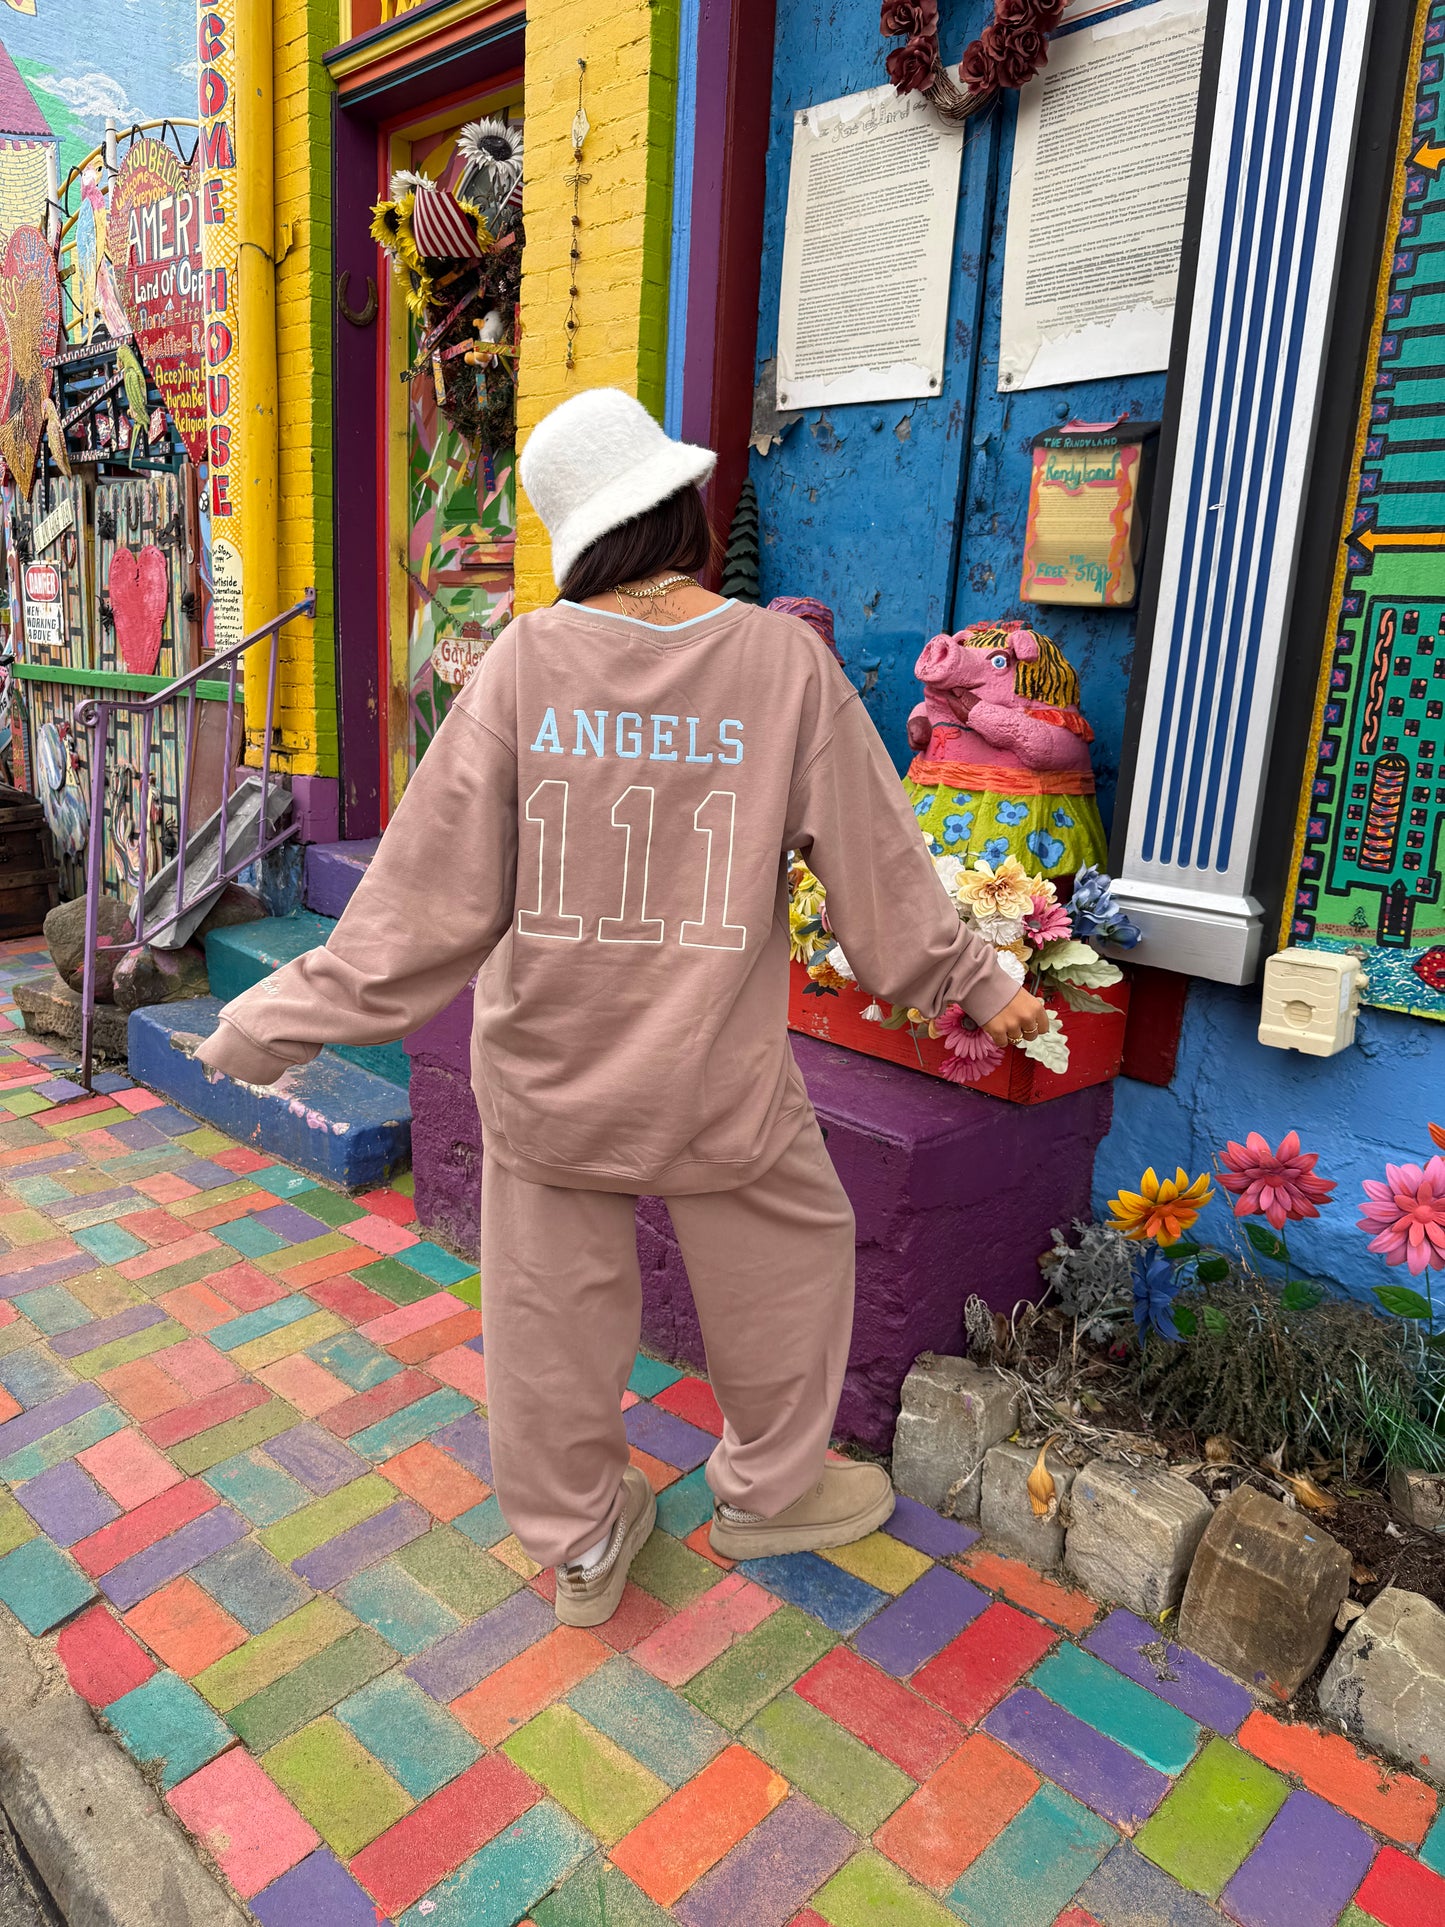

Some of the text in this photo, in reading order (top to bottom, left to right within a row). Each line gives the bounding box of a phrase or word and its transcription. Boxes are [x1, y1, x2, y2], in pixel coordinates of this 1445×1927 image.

[126, 141, 147, 174] YOU
[148, 141, 187, 201] BELONG
[115, 171, 149, 210] Welcome
[132, 185, 168, 208] Everyone
[200, 0, 236, 517] COME HOUSE
[134, 272, 159, 304] Land
[161, 263, 176, 296] Of
[155, 363, 200, 390] Accepting
[166, 388, 191, 410] Human
[1043, 437, 1063, 448] THE
[28, 570, 56, 596] DANGER
[27, 606, 40, 617] MEN
[27, 617, 57, 630] WORKING
[28, 630, 52, 642] ABOVE
[530, 707, 744, 765] ANGELS
[517, 779, 747, 951] 111
